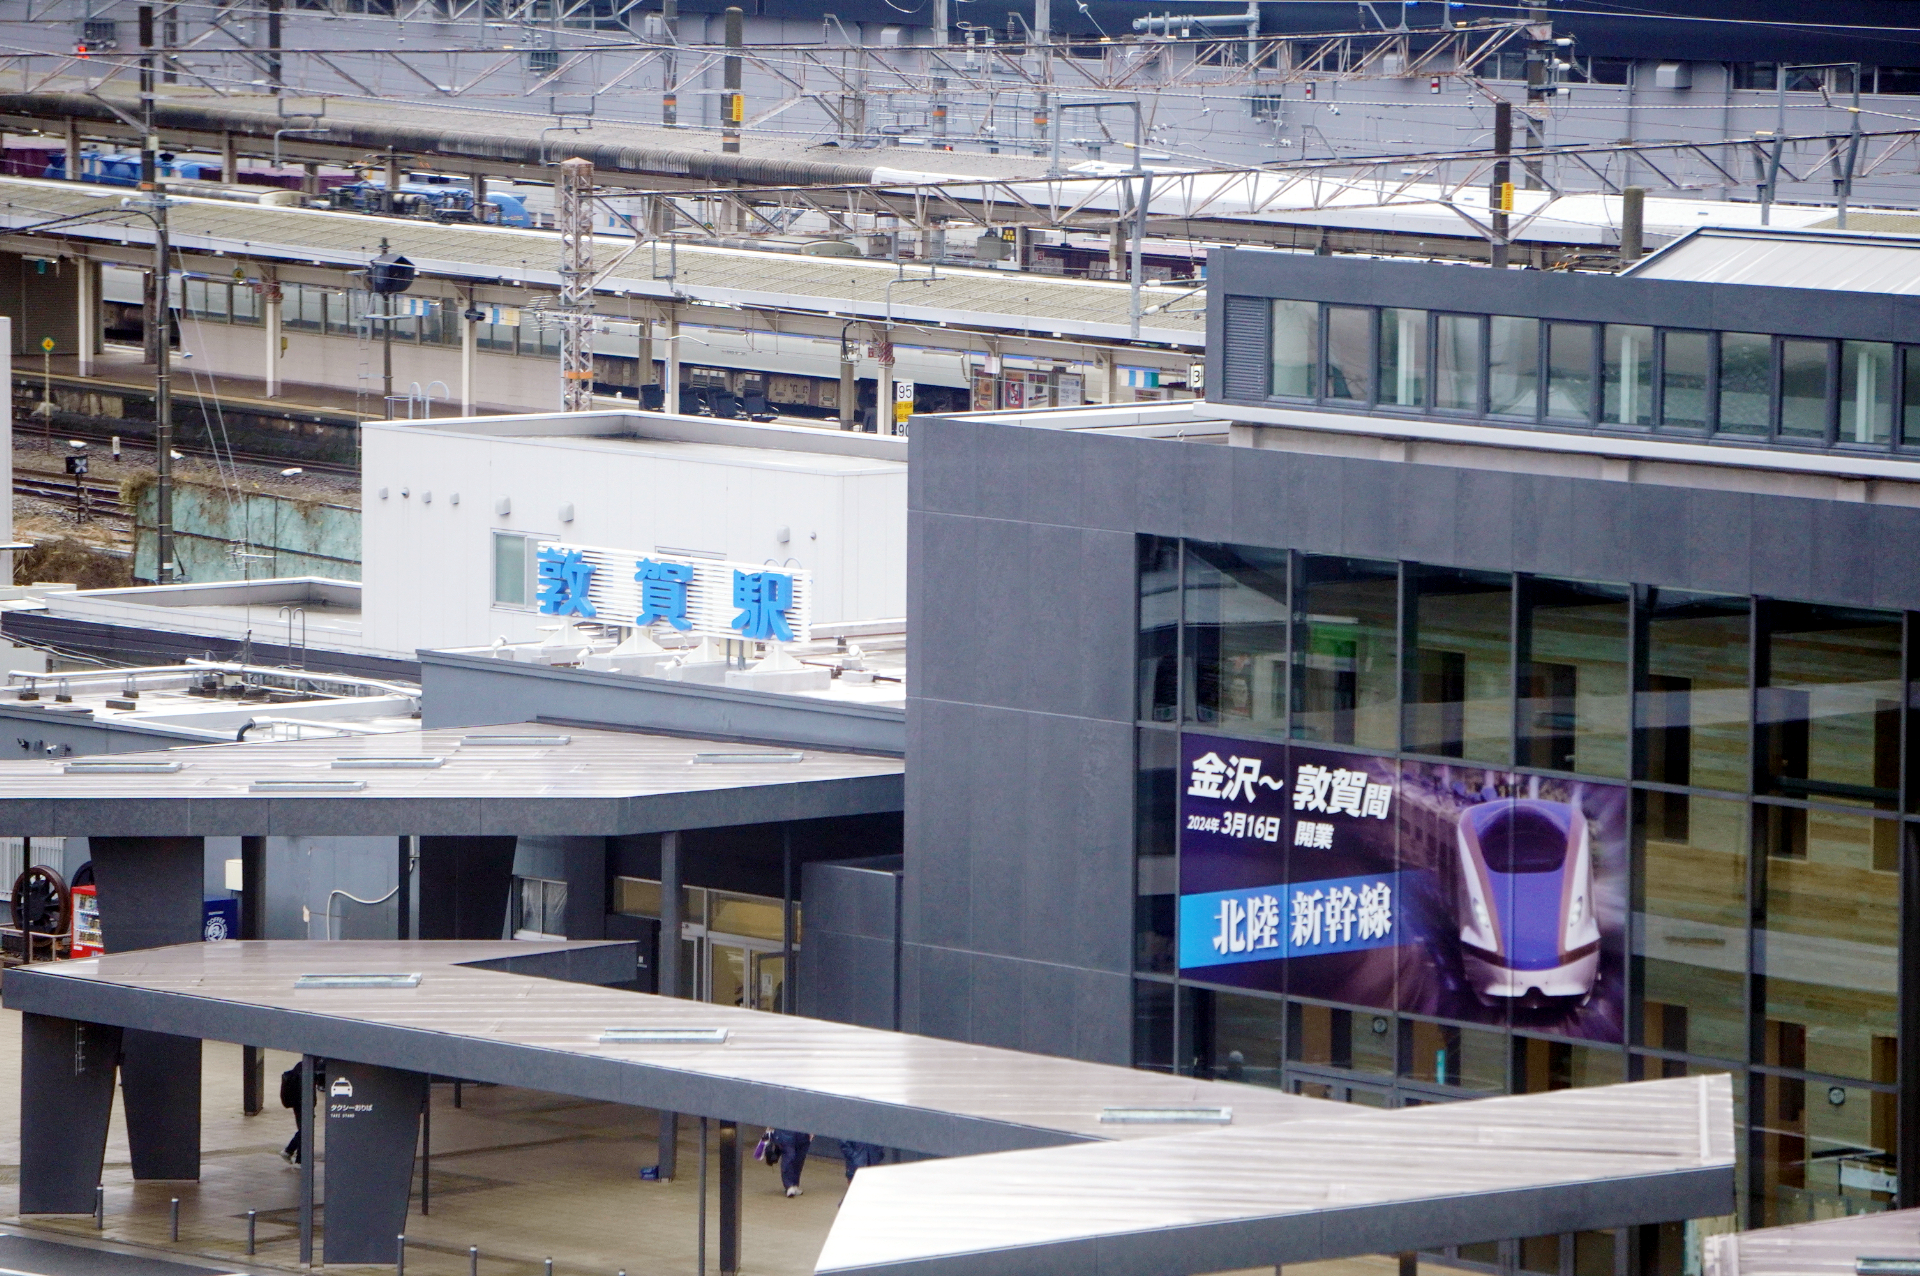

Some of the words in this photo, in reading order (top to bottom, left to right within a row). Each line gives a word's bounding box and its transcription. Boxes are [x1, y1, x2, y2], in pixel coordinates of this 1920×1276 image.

[1193, 370, 1200, 383] 3
[898, 385, 912, 399] 95
[536, 546, 795, 642] 敦賀駅
[1294, 820, 1335, 850] 開業
[206, 917, 226, 926] COFFEE
